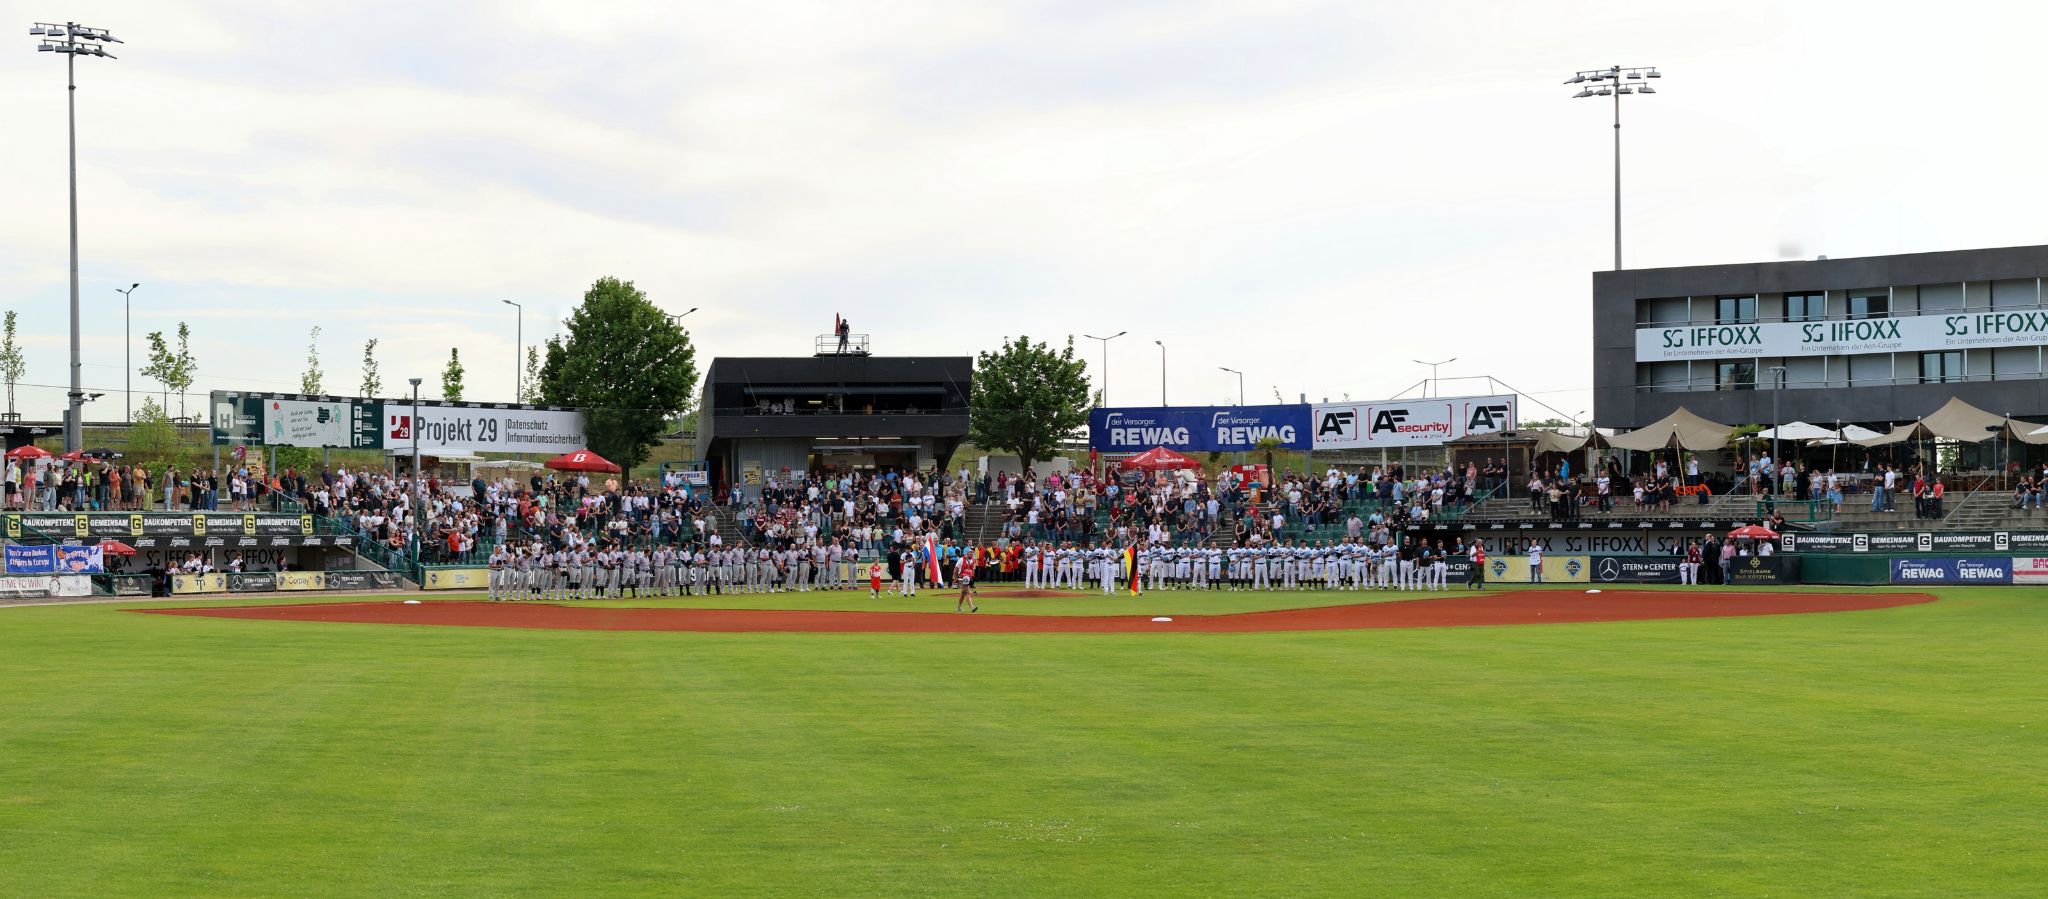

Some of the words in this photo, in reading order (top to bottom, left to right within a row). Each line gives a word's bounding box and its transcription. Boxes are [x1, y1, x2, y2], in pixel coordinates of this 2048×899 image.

[1802, 324, 1824, 342] SG
[1946, 316, 1968, 336] SG
[1663, 329, 1683, 348] SG
[1691, 326, 1761, 346] IFFOXX
[417, 417, 472, 445] Projekt
[478, 418, 497, 442] 29
[508, 419, 548, 430] Datenschutz
[400, 427, 408, 438] 29
[508, 433, 581, 444] Informationssicherheit
[1111, 428, 1189, 445] REWAG
[1218, 425, 1296, 445] REWAG
[1565, 537, 1582, 552] SG
[1588, 537, 1644, 552] IFFOXX
[1902, 568, 1944, 578] REWAG
[1960, 568, 2002, 578] REWAG
[18, 579, 26, 588] TO
